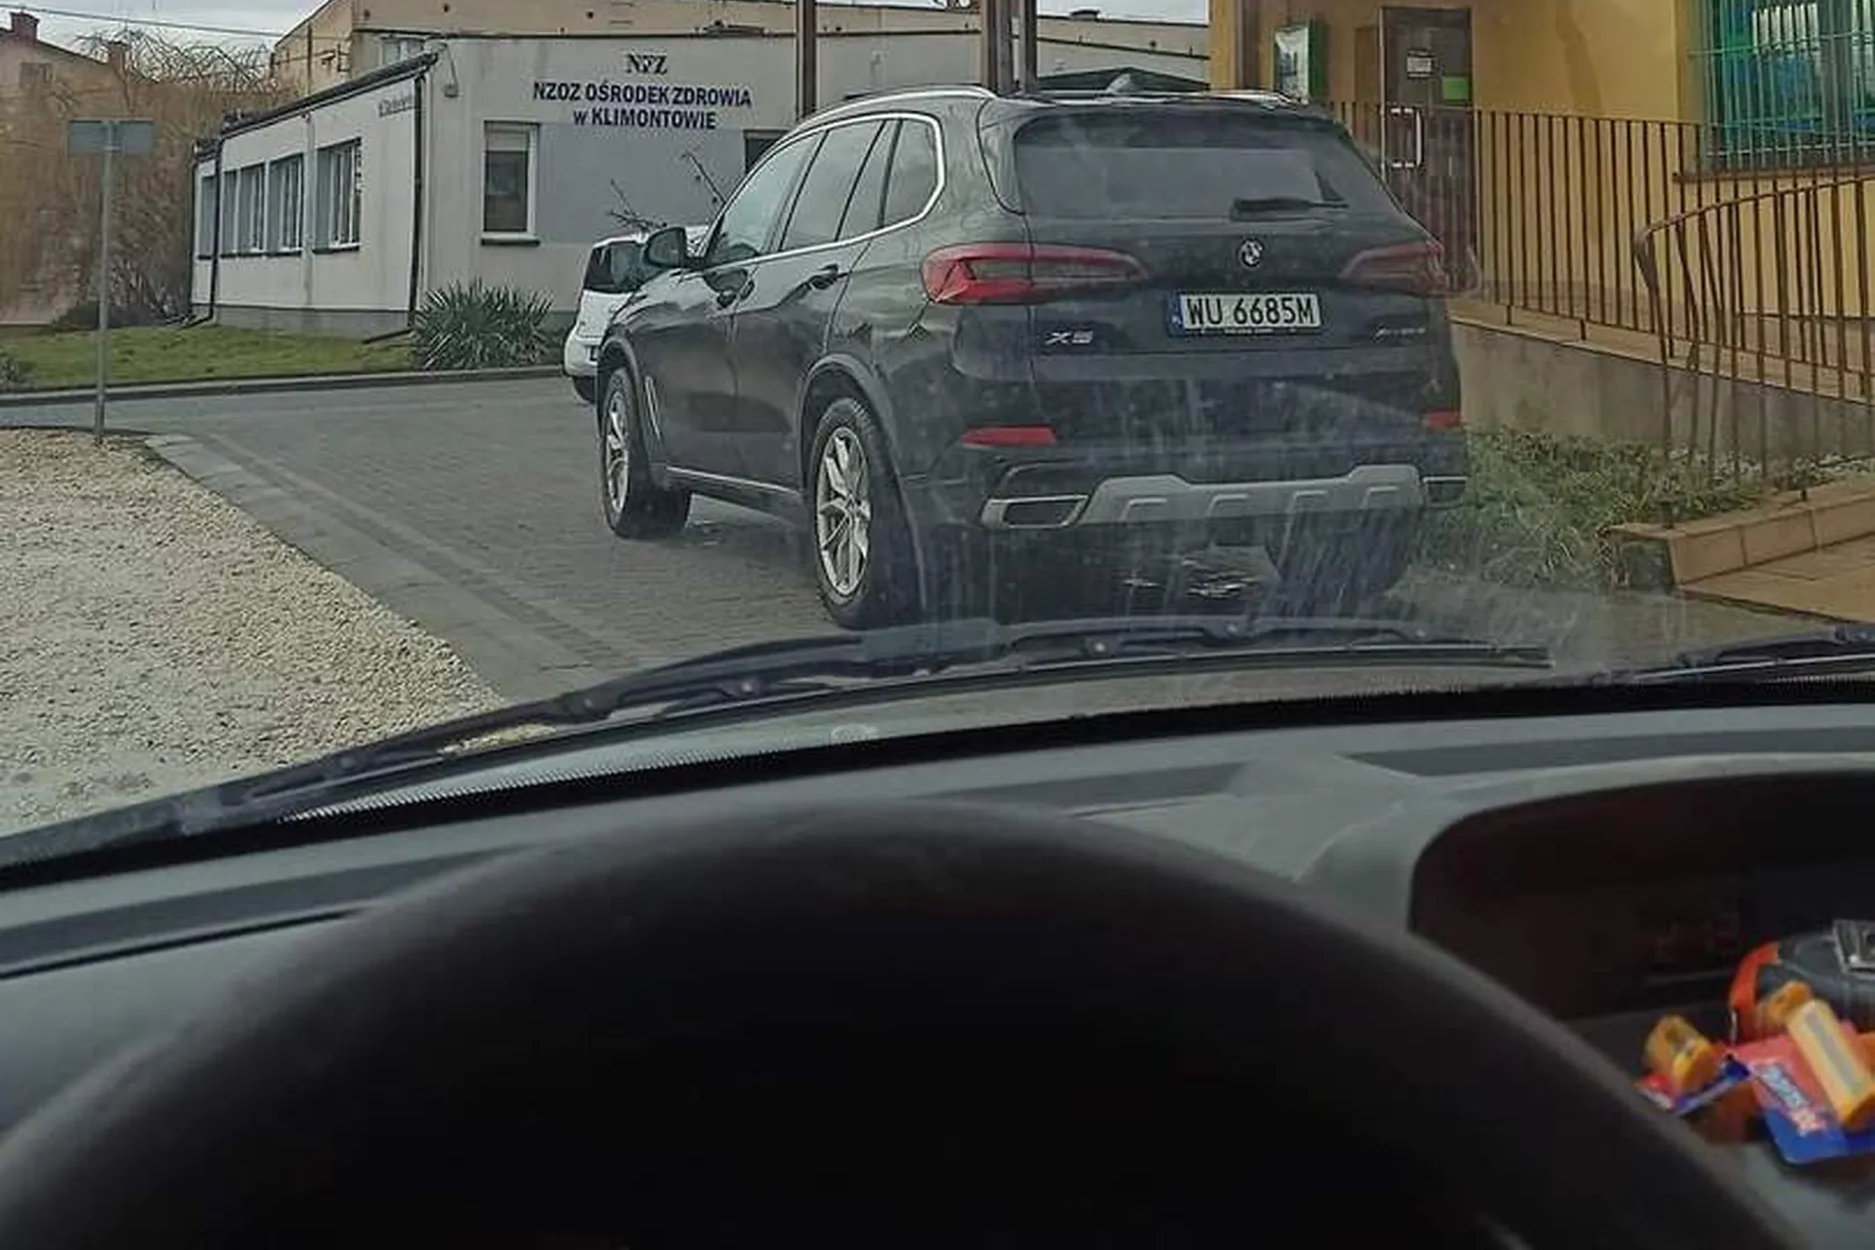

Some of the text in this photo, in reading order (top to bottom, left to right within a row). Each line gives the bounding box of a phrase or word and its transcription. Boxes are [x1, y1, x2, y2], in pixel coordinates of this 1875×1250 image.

[533, 78, 752, 108] NZOZ OŚRODEK ZDROWIA
[591, 108, 717, 129] KLIMONTOWIE
[1187, 297, 1314, 325] WU 6685M
